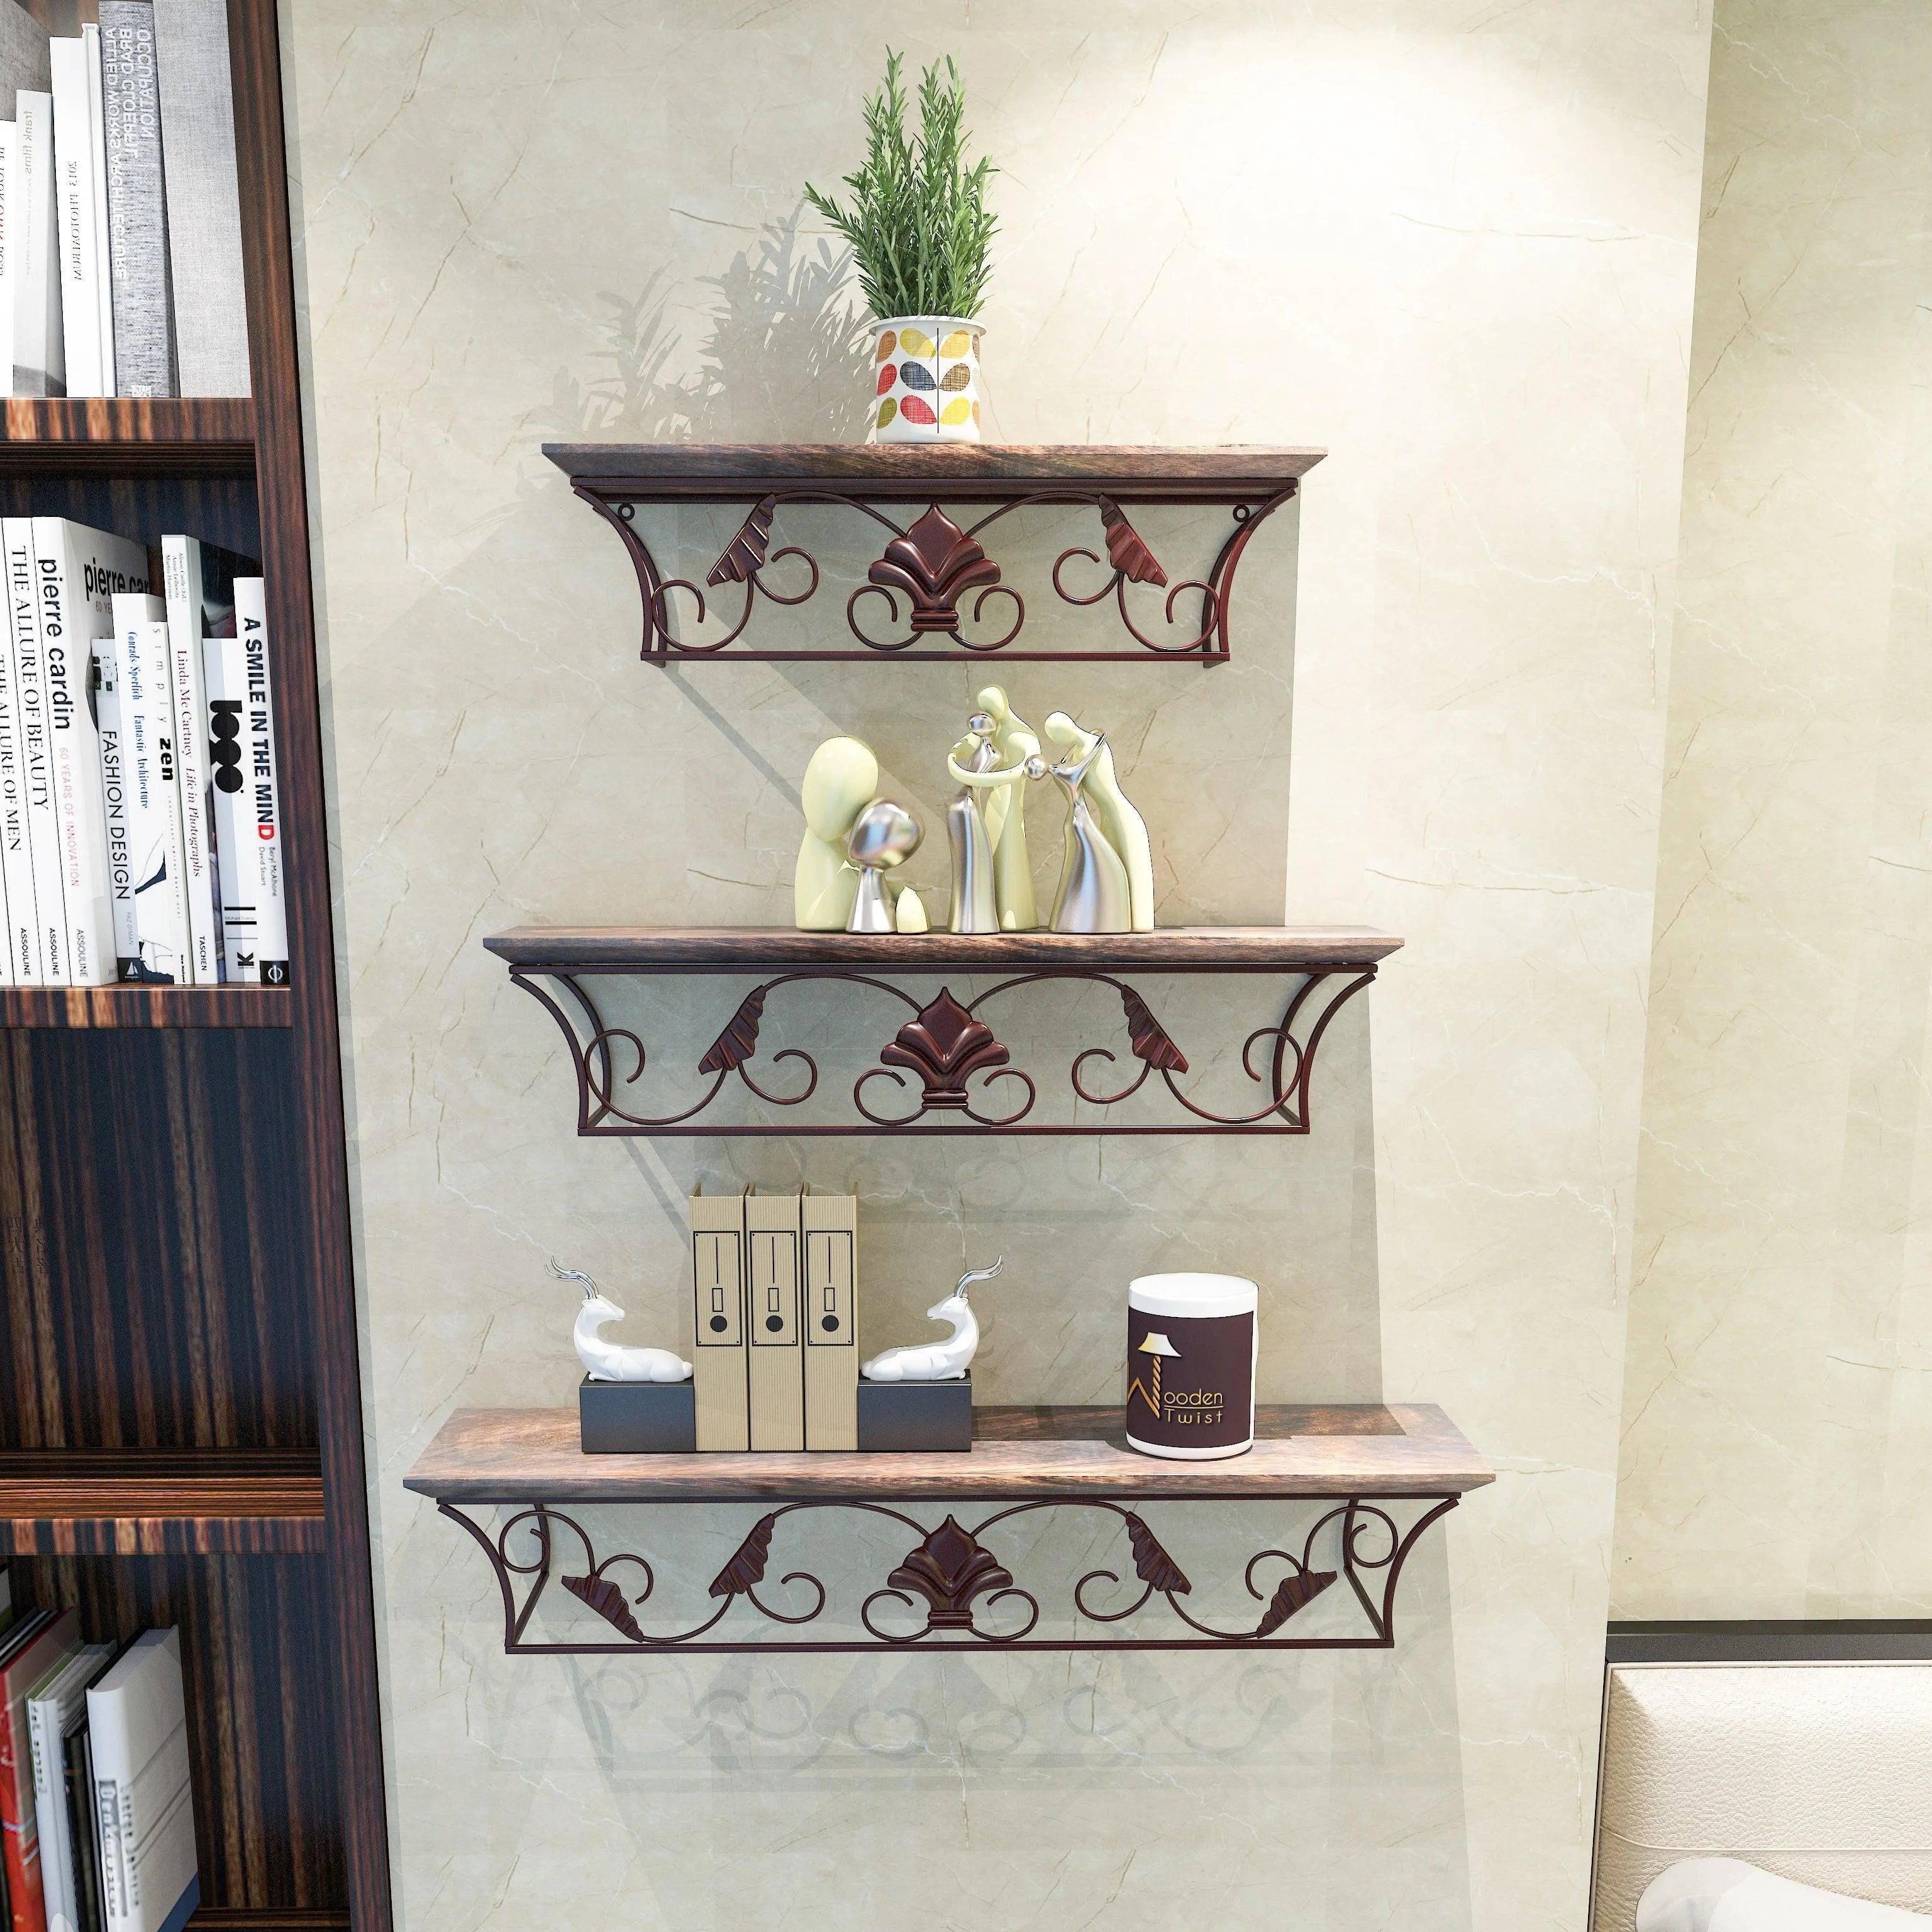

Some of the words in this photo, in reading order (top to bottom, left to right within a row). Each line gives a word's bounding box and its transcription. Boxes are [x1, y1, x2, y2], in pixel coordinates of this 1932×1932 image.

[12, 545, 30, 591] THE
[84, 557, 126, 601] pierre
[38, 558, 63, 638] pierre
[16, 599, 38, 685] ALLURE
[244, 617, 261, 632] A
[48, 648, 74, 730] cardin
[177, 650, 189, 686] Linda
[246, 638, 265, 703] SMILE
[24, 689, 41, 718] OF
[250, 711, 269, 733] IN
[133, 715, 147, 753] Fantastic
[26, 723, 48, 810] BEAUTY
[102, 730, 124, 819] FASHION
[159, 738, 174, 781] zen
[185, 767, 196, 790] Life
[253, 739, 270, 778] THE
[4, 779, 17, 804] OF
[60, 762, 74, 800] YEARS
[136, 757, 150, 809] Architecture
[188, 792, 197, 804] in
[6, 809, 21, 851] MEN
[65, 803, 74, 817] OF
[255, 784, 274, 841] MIND
[66, 821, 79, 887] INNOVATION
[110, 827, 130, 900] DESIGN
[188, 807, 203, 877] Photographs
[21, 928, 31, 976] ASSOULINE
[49, 928, 60, 976] ASSOULINE
[75, 928, 89, 978] ASSOULINE
[198, 935, 208, 971] TASCHEN
[1163, 1408, 1223, 1424] Twist
